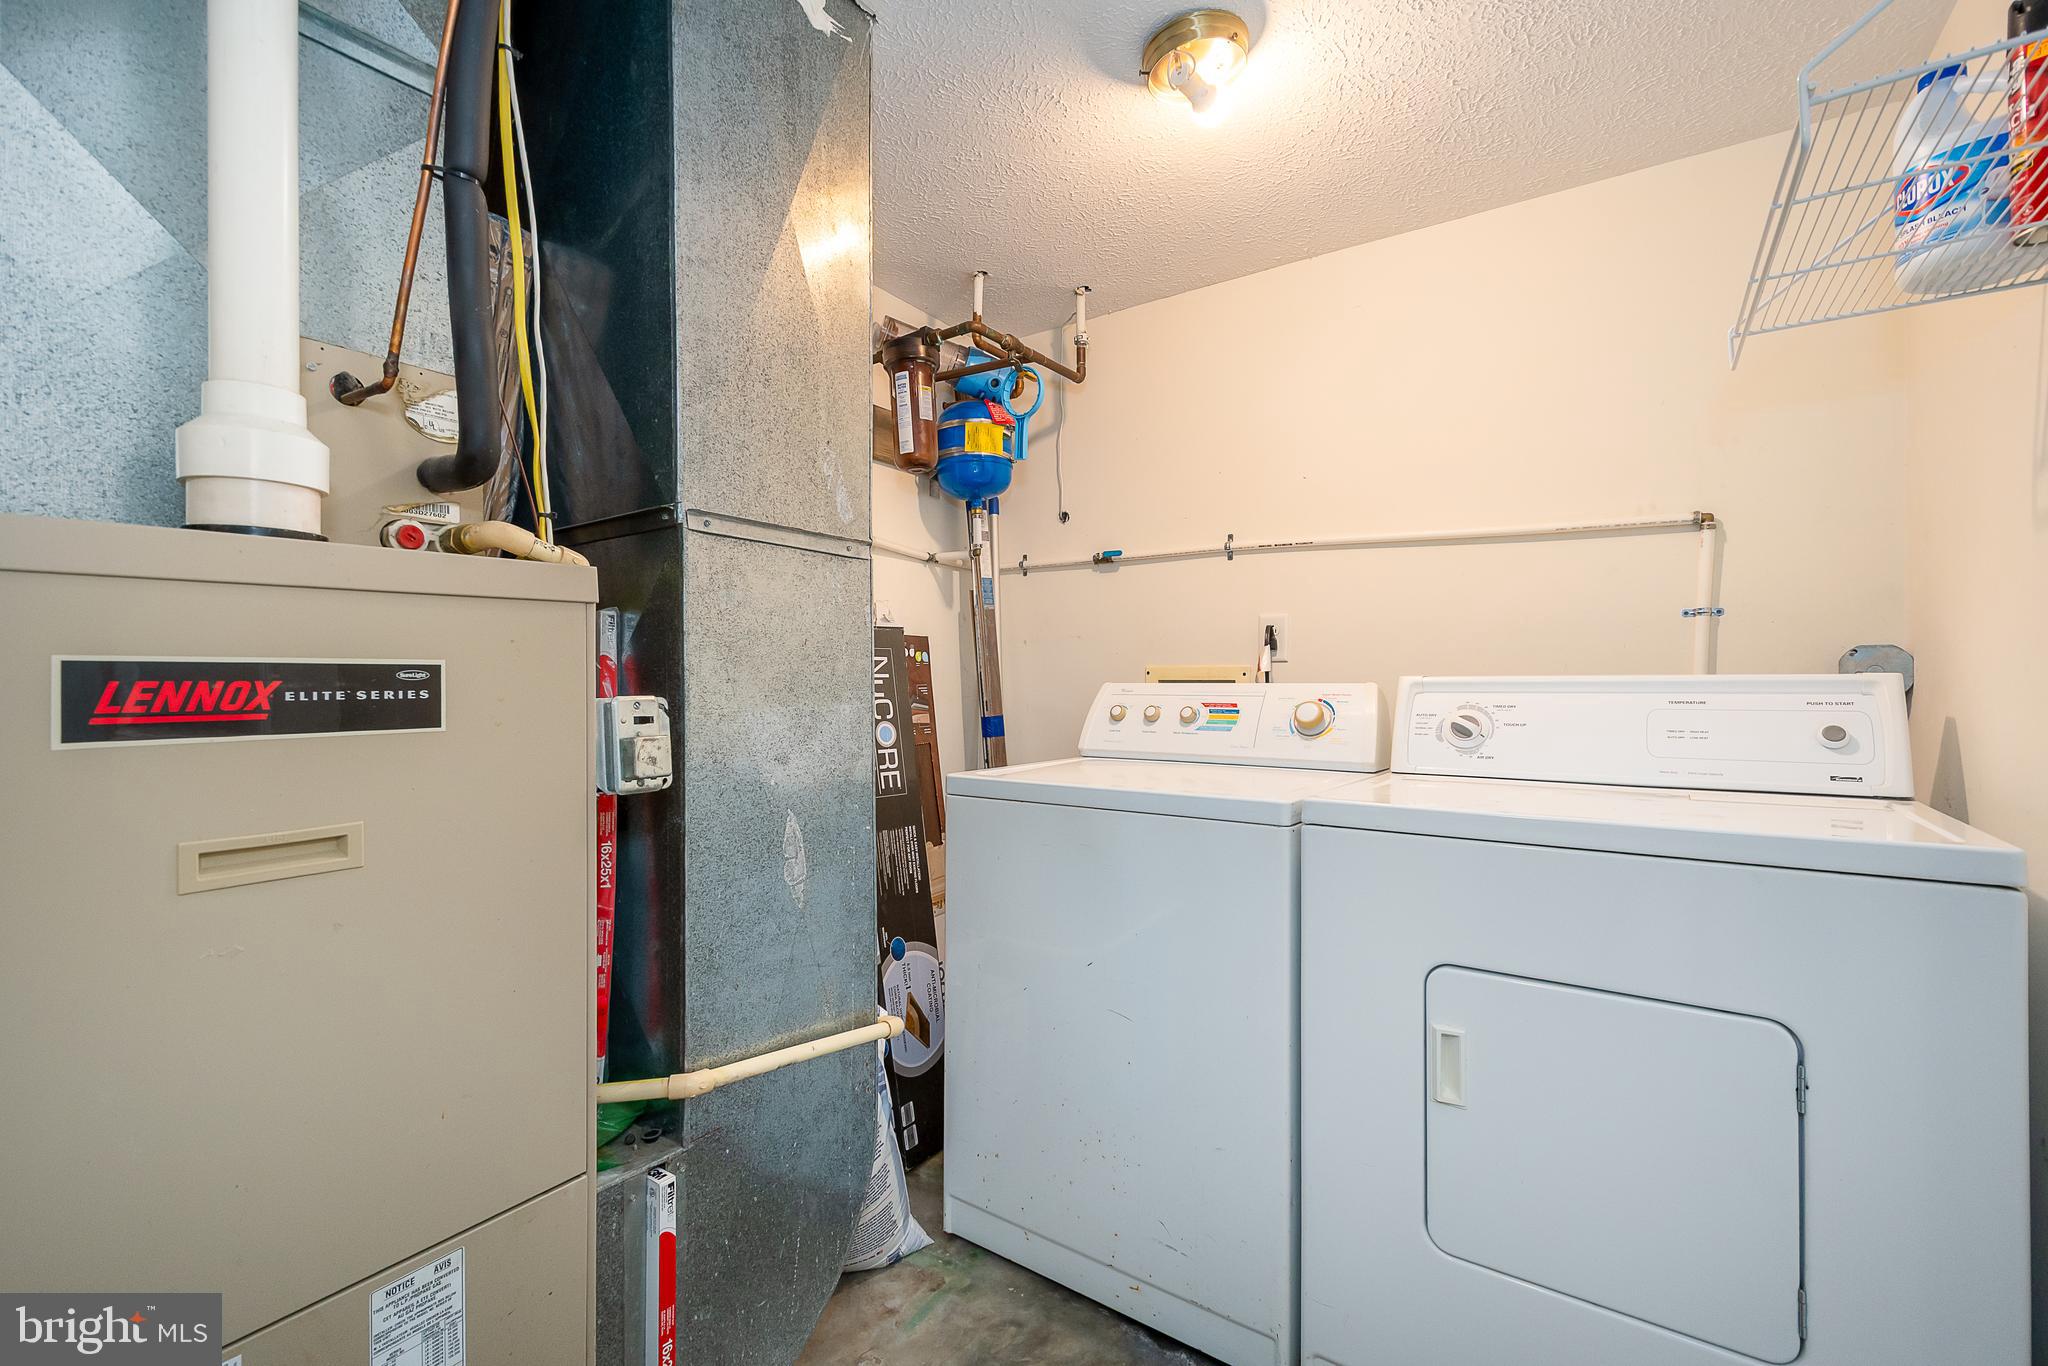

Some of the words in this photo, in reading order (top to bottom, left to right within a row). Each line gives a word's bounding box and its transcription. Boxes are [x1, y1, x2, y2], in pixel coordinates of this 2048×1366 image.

[93, 680, 283, 714] LENNOX
[284, 691, 346, 701] ELITE
[356, 689, 430, 700] SERIES
[599, 840, 612, 889] 16x25x1
[926, 983, 934, 1013] COATING
[930, 969, 940, 1023] ANTI-MICROBIAL
[433, 1259, 451, 1273] AVIS
[385, 1277, 414, 1298] NOTICE
